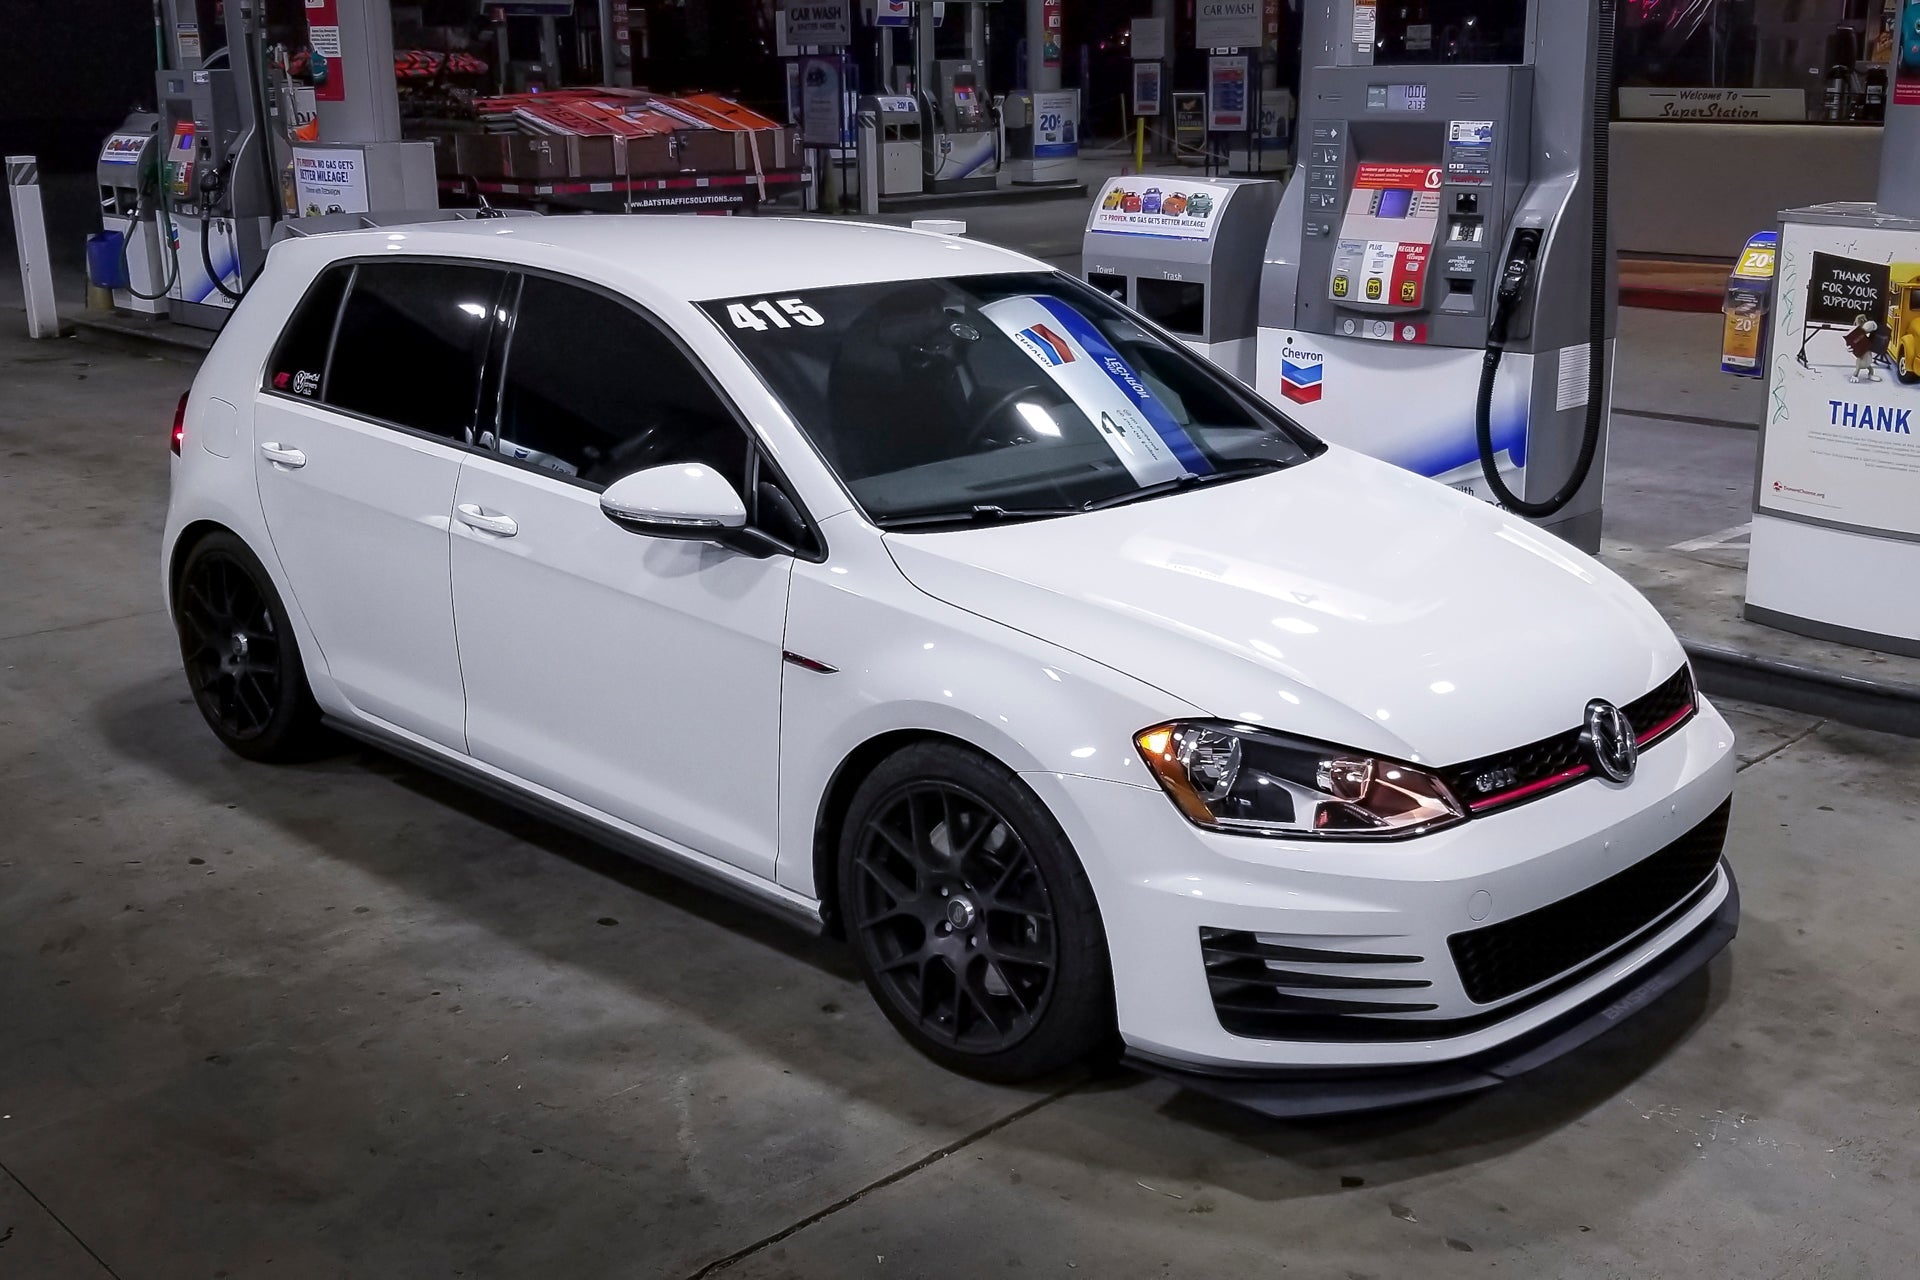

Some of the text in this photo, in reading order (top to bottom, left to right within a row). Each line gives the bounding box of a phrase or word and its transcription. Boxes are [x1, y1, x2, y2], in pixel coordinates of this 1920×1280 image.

[791, 7, 841, 21] CAR WASH
[1204, 4, 1254, 16] CAR WASH
[1680, 91, 1738, 101] Welcome To
[1659, 102, 1758, 118] SuperStation
[318, 160, 325, 168] NO
[326, 161, 337, 169] GAS
[338, 161, 354, 170] GETS
[317, 171, 349, 183] MILEAGE!
[1137, 216, 1147, 224] GAS
[1148, 217, 1160, 225] GETS
[1161, 218, 1180, 226] BETTER
[1181, 220, 1206, 228] MILEAGE!
[1398, 245, 1424, 253] REGULAR
[1096, 264, 1115, 274] Towel
[1163, 271, 1182, 280] Trash
[1832, 269, 1871, 284] THANKS
[1821, 282, 1878, 300] FOR YOUR
[1822, 295, 1873, 311] SUPPORT!
[726, 298, 825, 331] 415
[1282, 347, 1323, 361] Chevron
[1829, 400, 1912, 435] THANK
